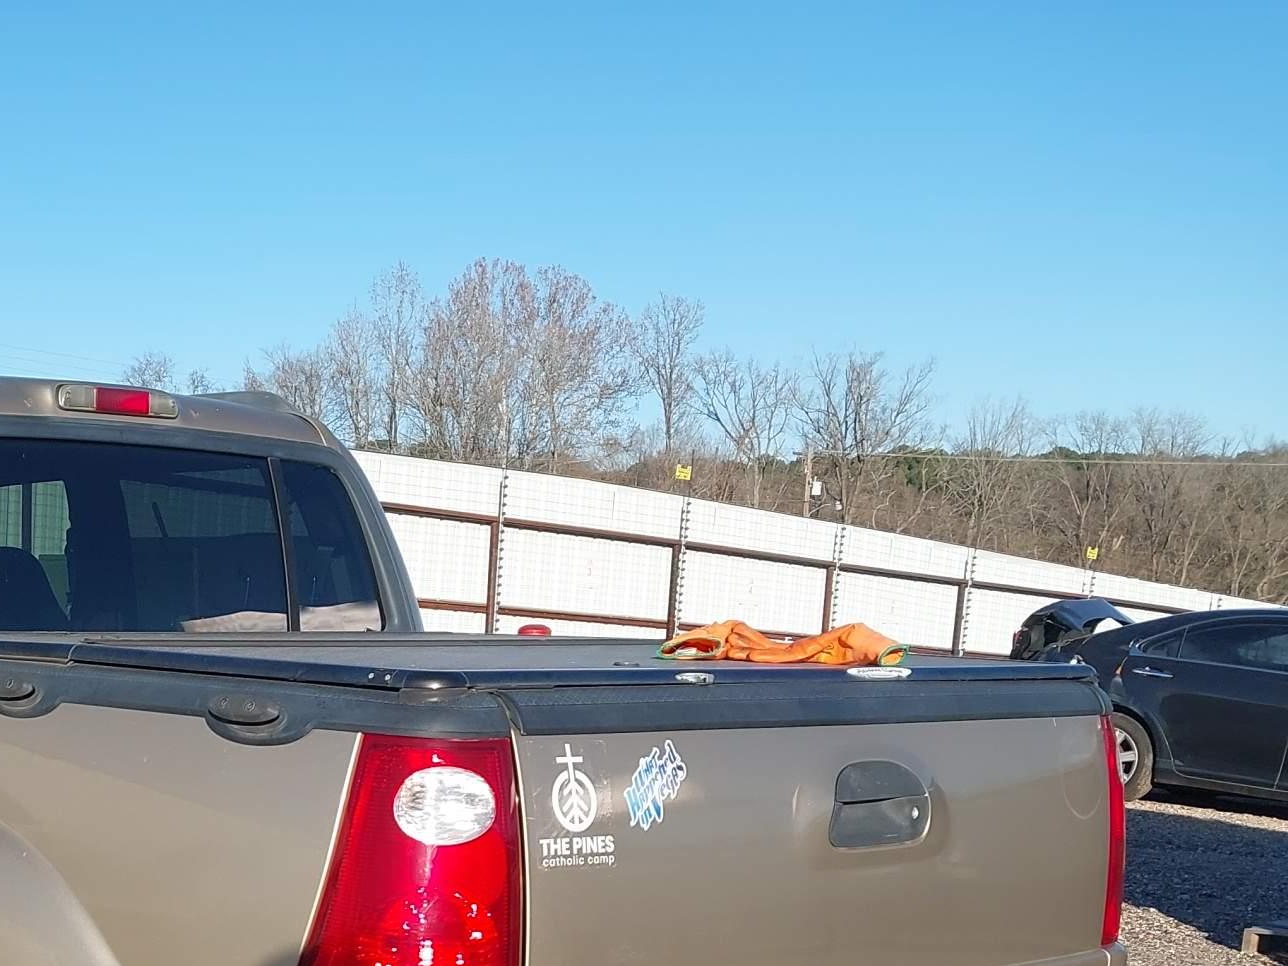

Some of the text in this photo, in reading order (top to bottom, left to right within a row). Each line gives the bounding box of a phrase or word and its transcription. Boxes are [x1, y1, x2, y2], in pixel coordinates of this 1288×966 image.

[539, 835, 615, 857] THE PINES
[542, 855, 615, 867] catholic camp
